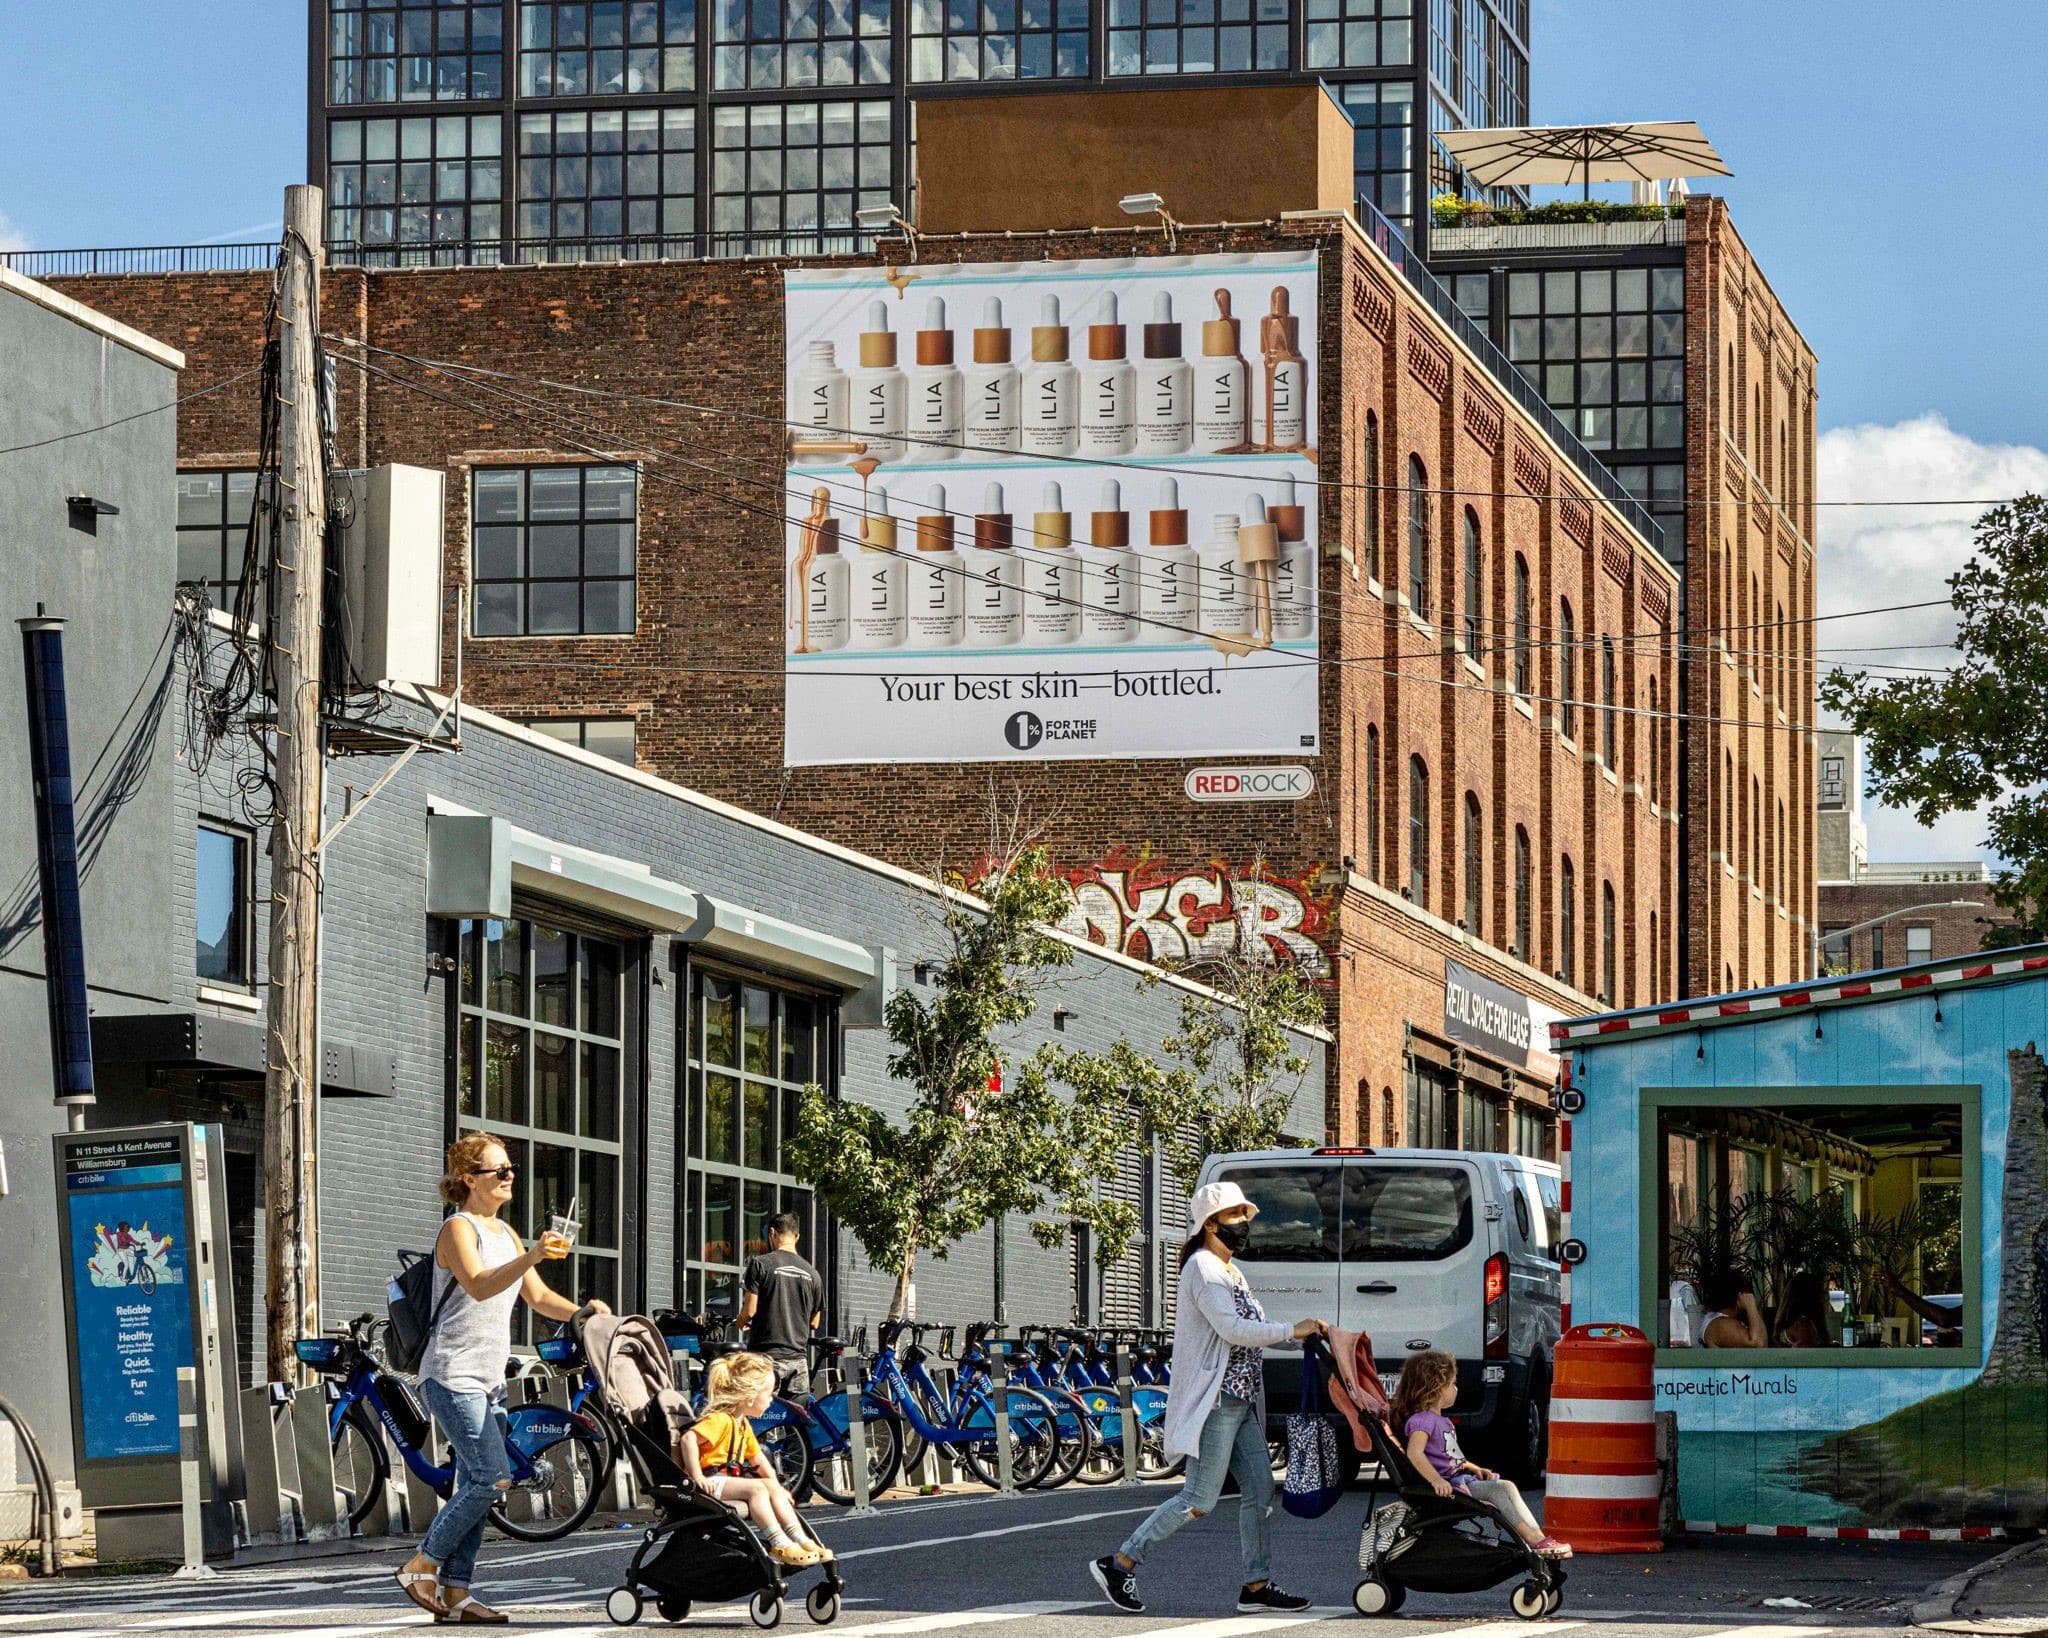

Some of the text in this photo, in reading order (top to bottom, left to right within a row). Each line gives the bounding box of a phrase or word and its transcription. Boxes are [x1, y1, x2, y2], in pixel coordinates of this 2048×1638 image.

[813, 384, 828, 425] ILIA
[869, 384, 885, 425] ILIA
[927, 382, 942, 423] ILIA
[985, 379, 1000, 420] ILIA
[1041, 379, 1057, 420] ILIA
[1099, 377, 1115, 418] ILIA
[1157, 375, 1172, 416] ILIA
[1215, 373, 1231, 414] ILIA
[1273, 370, 1289, 412] ILIA
[811, 571, 827, 612] ILIA
[872, 569, 887, 610] ILIA
[929, 568, 945, 609] ILIA
[985, 566, 1001, 607] ILIA
[1045, 566, 1060, 606] ILIA
[1104, 563, 1119, 605] ILIA
[1161, 562, 1177, 603] ILIA
[1219, 559, 1234, 600] ILIA
[1278, 559, 1293, 600] ILIA
[879, 676, 946, 701] Your
[953, 674, 1012, 701] best
[1045, 719, 1097, 730] FOR THE
[1045, 729, 1097, 740] PLANET
[1446, 980, 1529, 1050] RETAIL SPACE FOR LEASE
[76, 1148, 83, 1156] N
[92, 1145, 116, 1155] Street
[117, 1144, 123, 1152] &
[124, 1143, 142, 1151] Kent
[143, 1141, 172, 1150] Avenue
[77, 1159, 127, 1169] Williamsburg
[116, 1304, 152, 1316] Reliable
[118, 1330, 153, 1342] Healthy
[124, 1356, 151, 1368] Quick
[130, 1378, 147, 1389] Fun
[1654, 1373, 1798, 1400] rapeutic Murals
